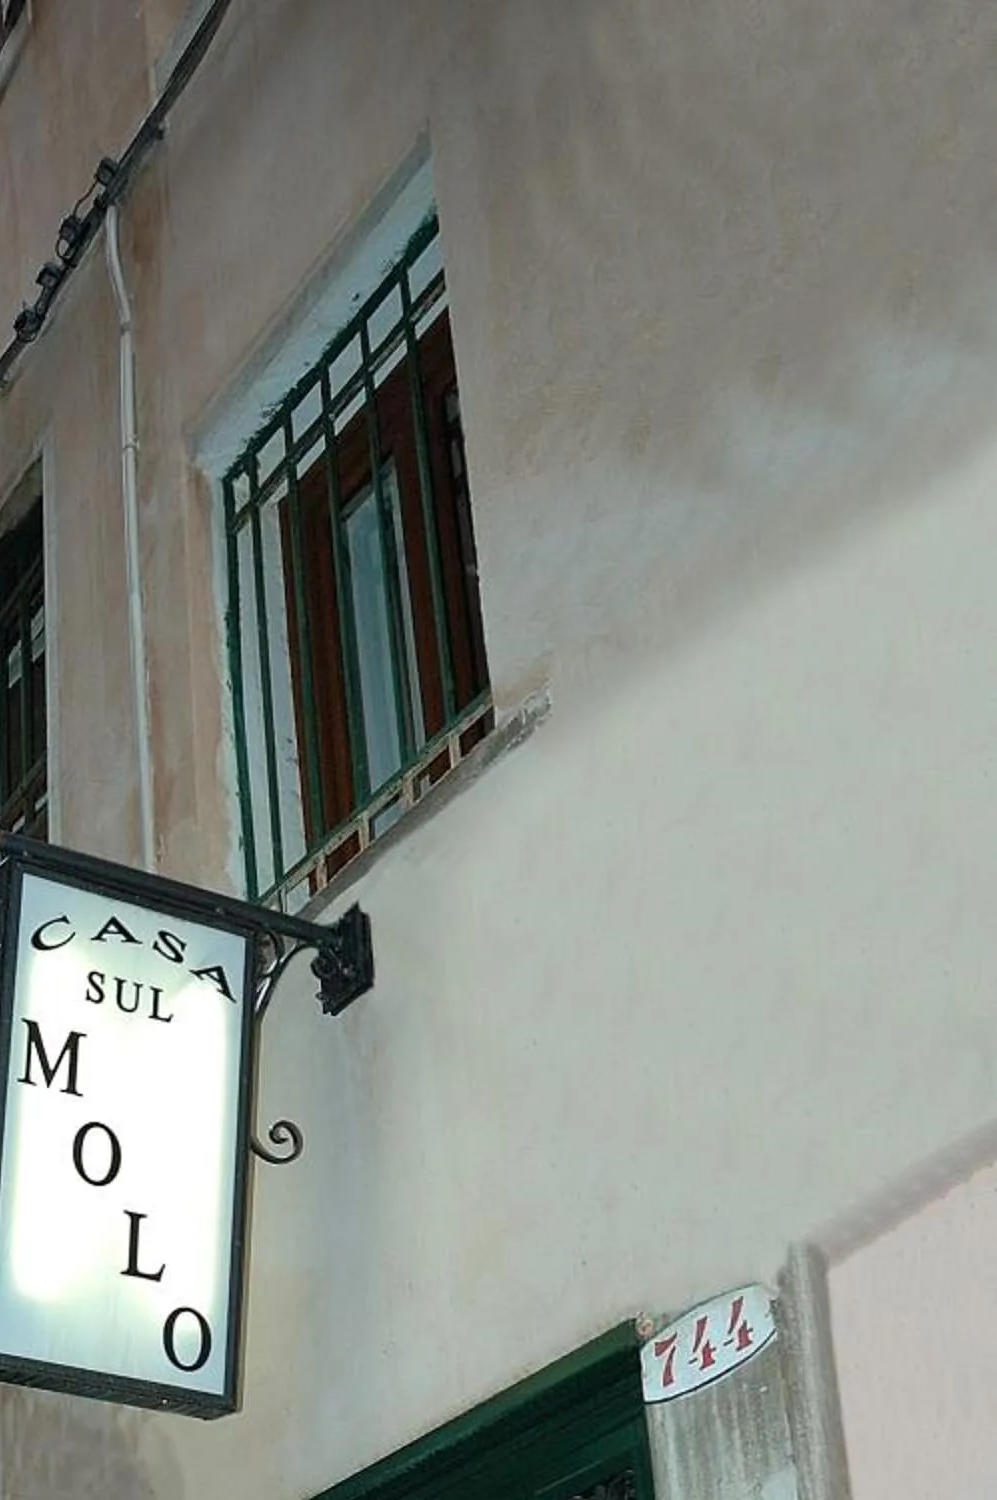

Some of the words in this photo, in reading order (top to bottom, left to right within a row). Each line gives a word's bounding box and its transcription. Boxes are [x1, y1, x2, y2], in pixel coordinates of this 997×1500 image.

[30, 915, 237, 1004] CASA
[85, 970, 175, 1024] SUL
[16, 1017, 213, 1373] MOLO
[654, 1295, 754, 1388] 744
